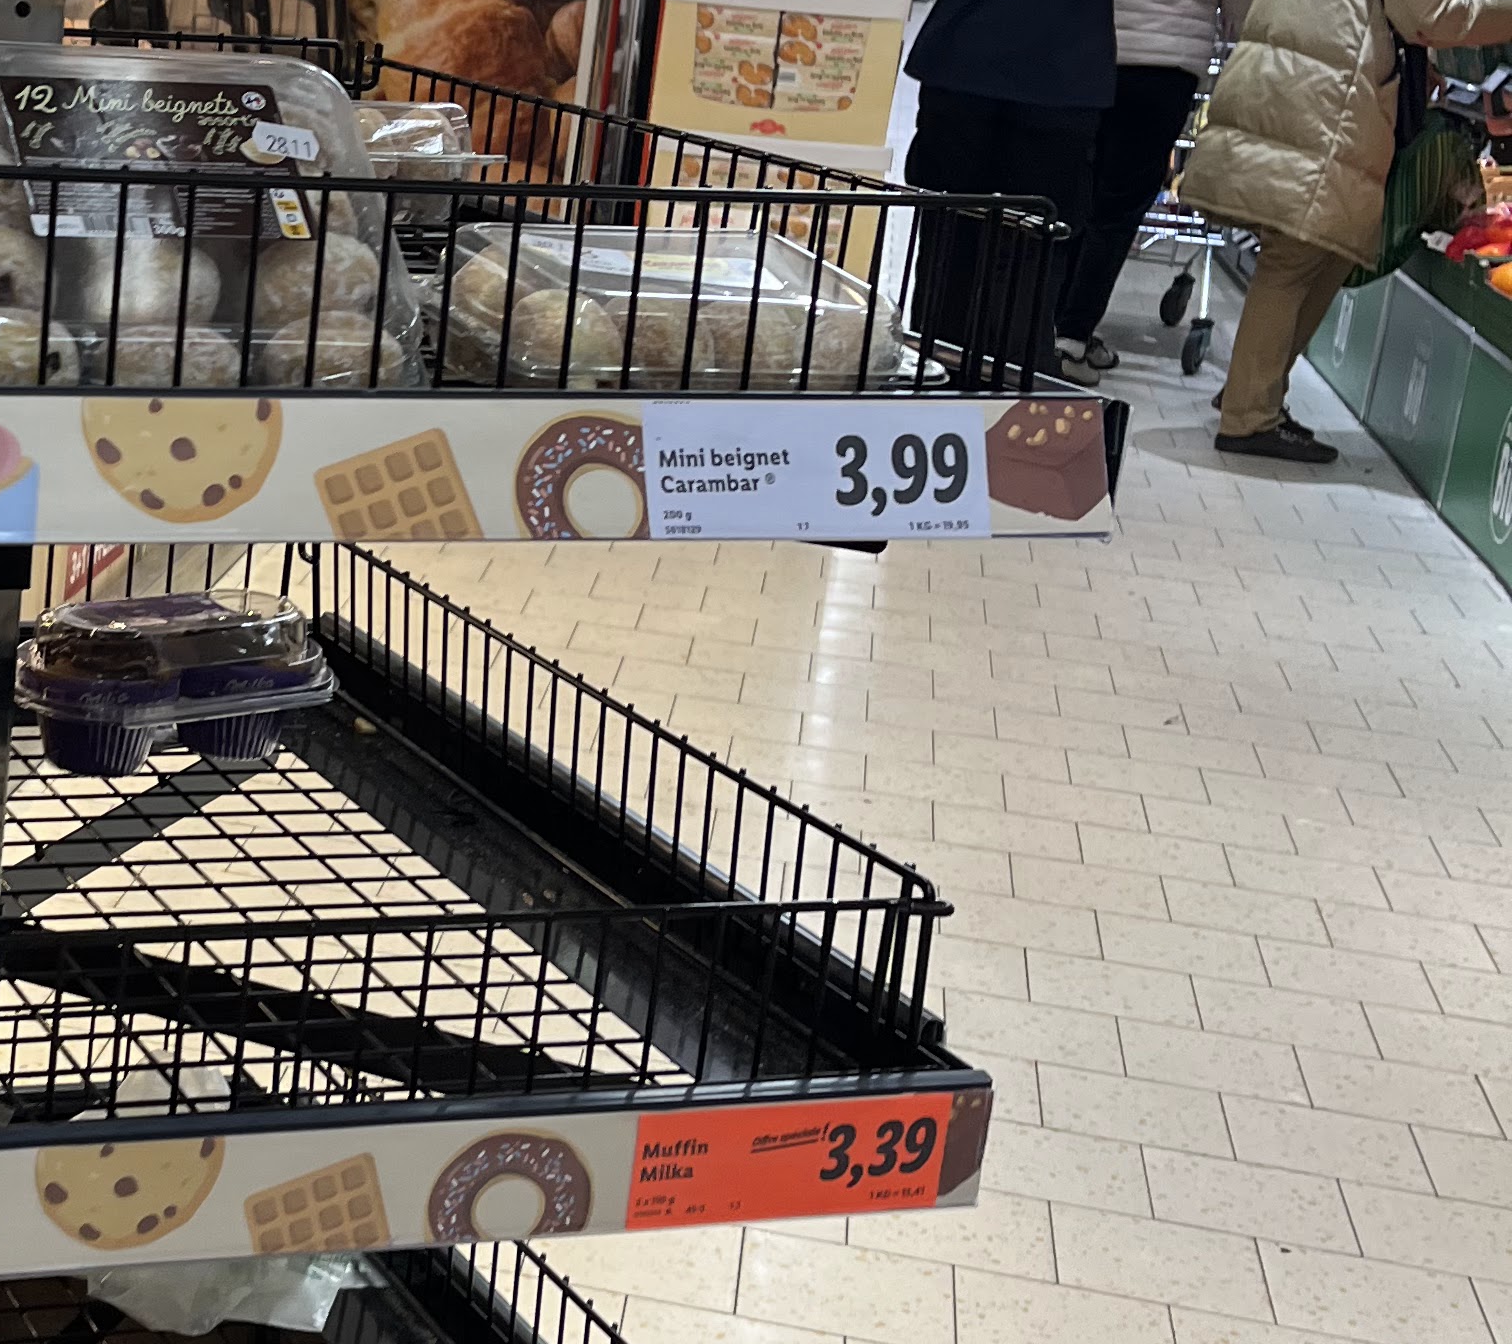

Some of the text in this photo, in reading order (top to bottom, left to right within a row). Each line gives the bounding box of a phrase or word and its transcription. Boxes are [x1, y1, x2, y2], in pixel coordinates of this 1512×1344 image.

[14, 84, 239, 123] 12 Mini beignets
[659, 447, 790, 471] Mini beignet
[661, 476, 759, 494] Carambar
[835, 433, 969, 517] 3,99
[642, 1138, 709, 1160] Muffin
[820, 1117, 938, 1188] 3,39
[640, 1165, 694, 1183] Milka
